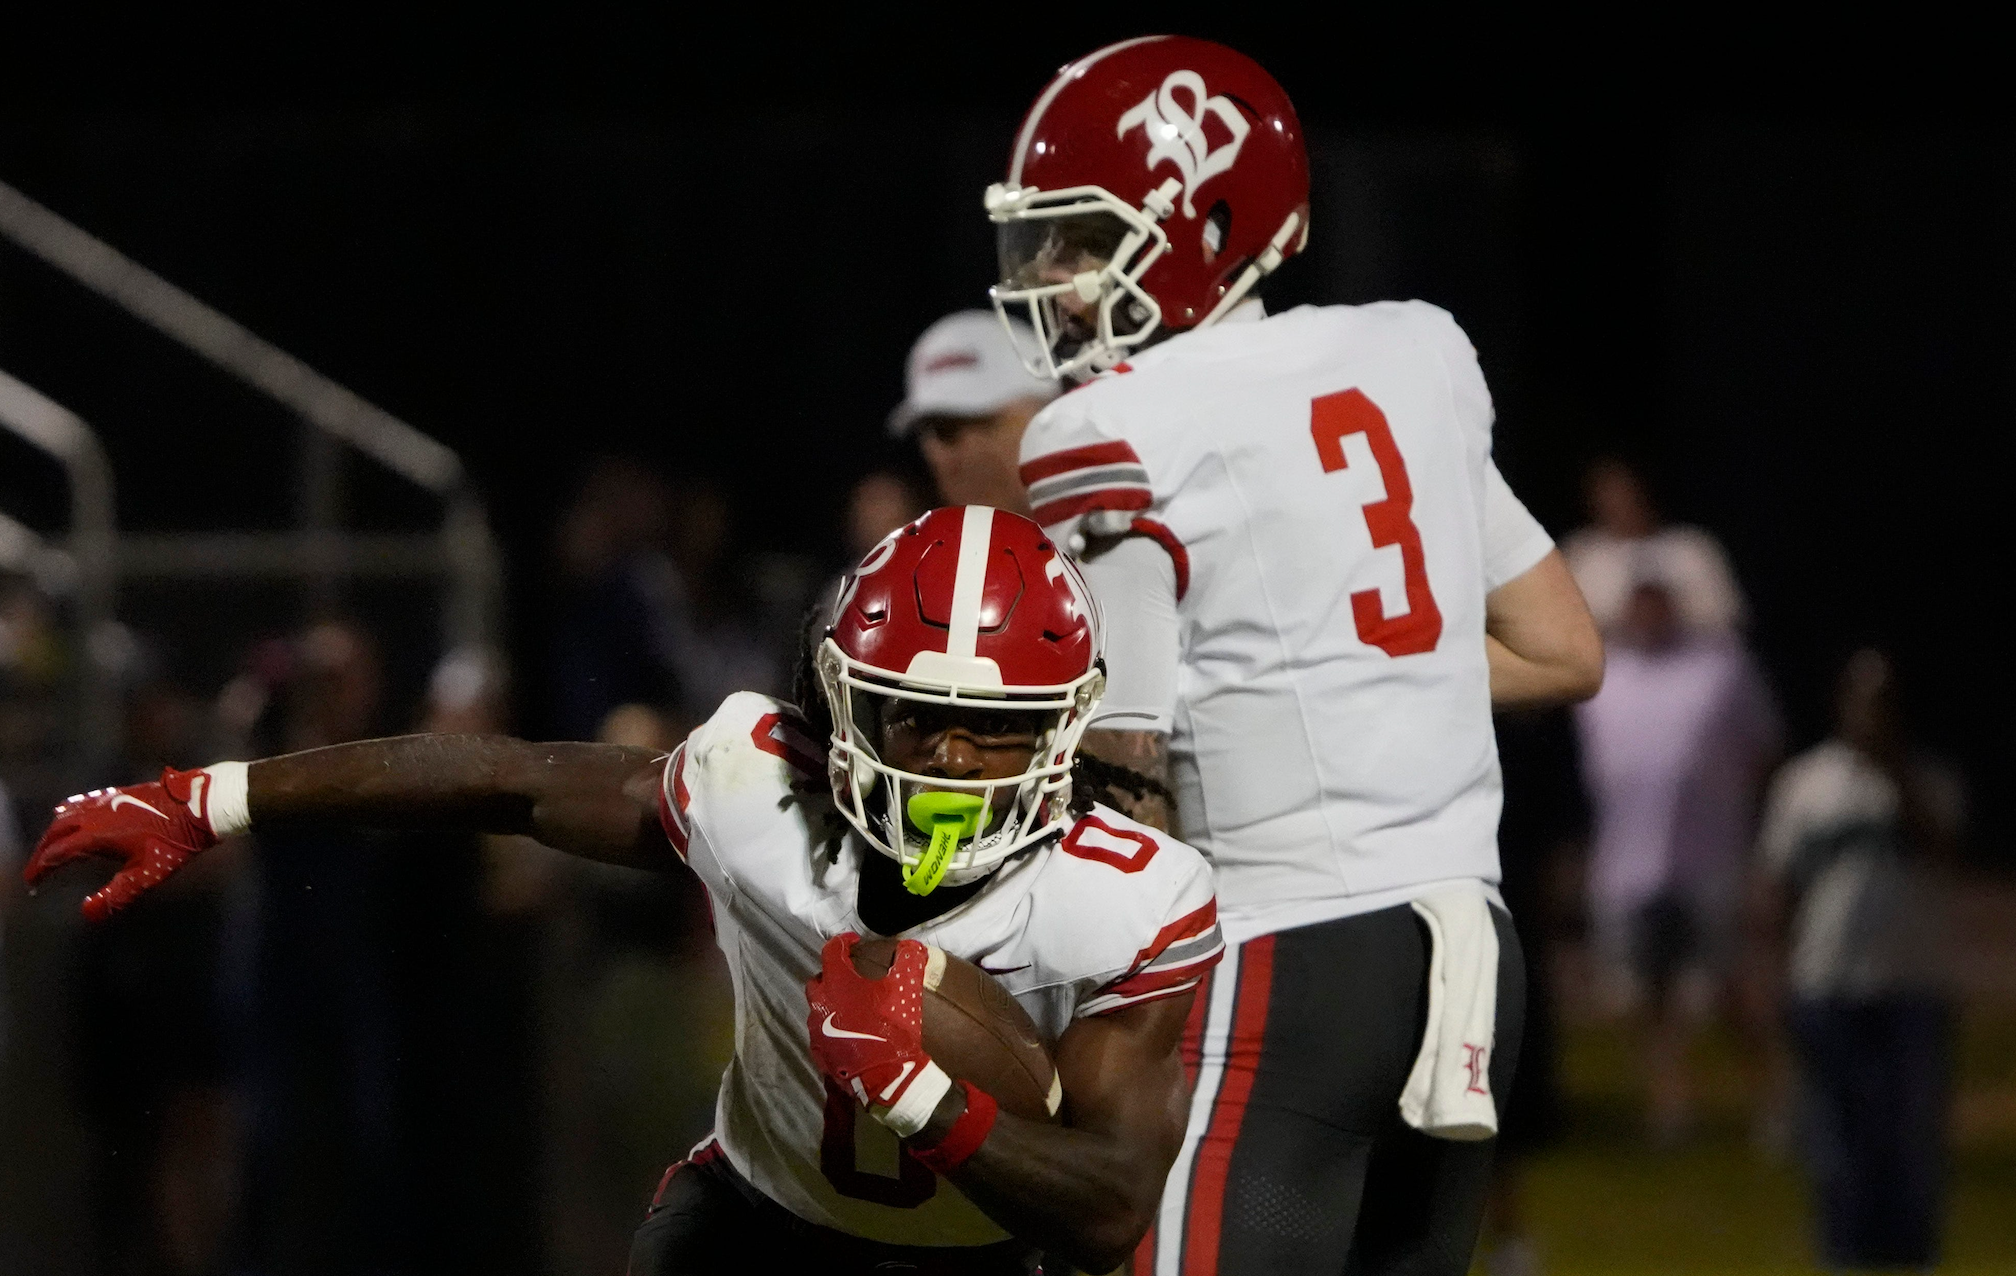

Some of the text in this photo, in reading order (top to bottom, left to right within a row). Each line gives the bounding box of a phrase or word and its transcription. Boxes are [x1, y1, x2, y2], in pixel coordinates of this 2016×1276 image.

[1310, 386, 1443, 658] 3
[922, 830, 953, 886] PHENOM
[1061, 814, 1160, 874] 0
